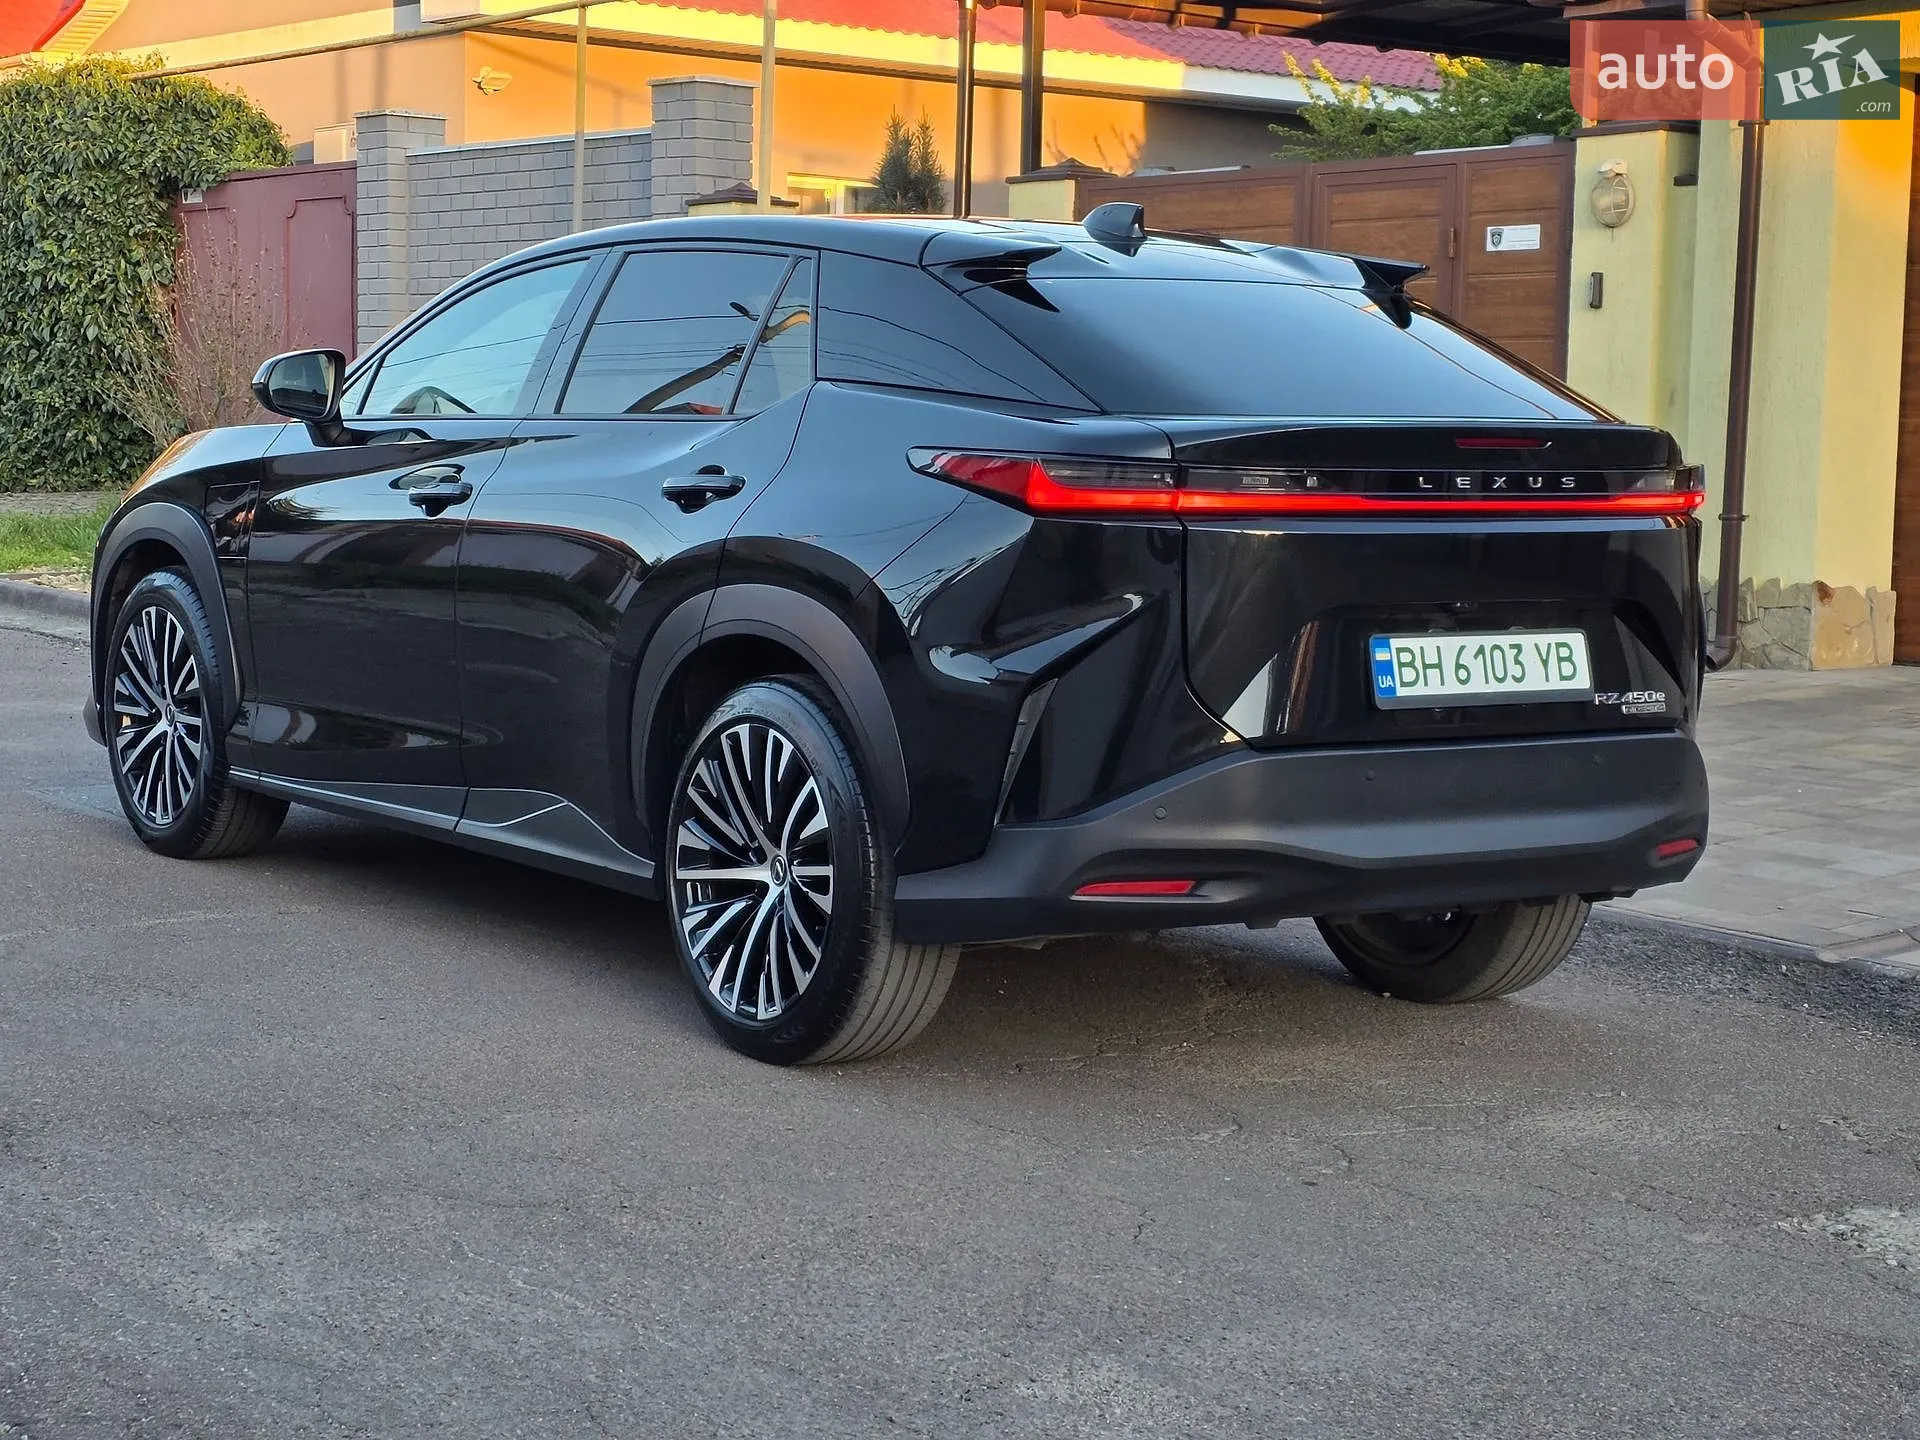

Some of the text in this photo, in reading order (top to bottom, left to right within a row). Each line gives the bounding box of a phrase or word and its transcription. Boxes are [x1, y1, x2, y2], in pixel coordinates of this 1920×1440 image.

[1418, 475, 1577, 489] LEXUS
[1395, 640, 1578, 688] BH 6103 YB
[1378, 675, 1394, 689] UA
[1595, 690, 1667, 705] RZ 450e
